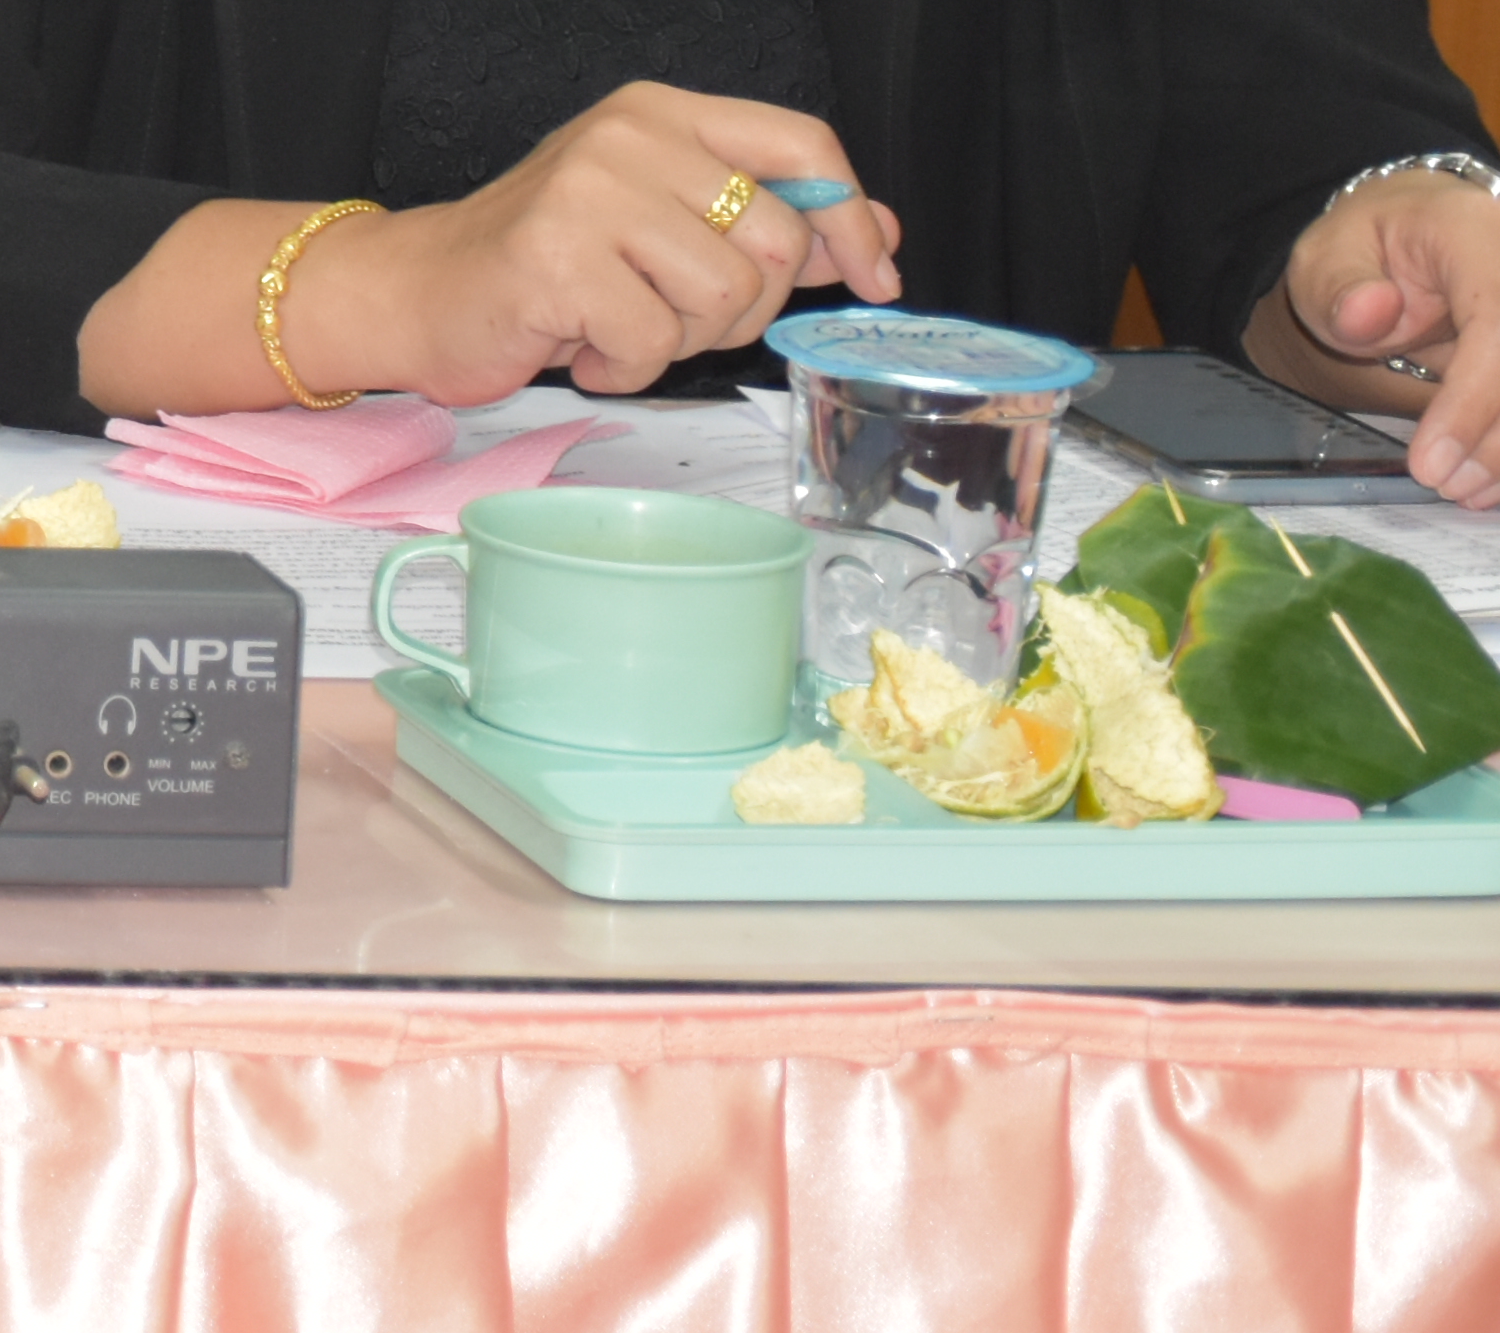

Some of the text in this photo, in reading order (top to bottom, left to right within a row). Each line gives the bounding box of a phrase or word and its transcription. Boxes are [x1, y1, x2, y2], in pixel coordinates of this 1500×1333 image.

[131, 637, 278, 678] NPE
[130, 678, 277, 692] RESEARCH
[149, 759, 217, 771] MIN MAX
[147, 779, 215, 794] VOLUME
[45, 790, 72, 804] EC
[84, 792, 141, 806] PHONE
